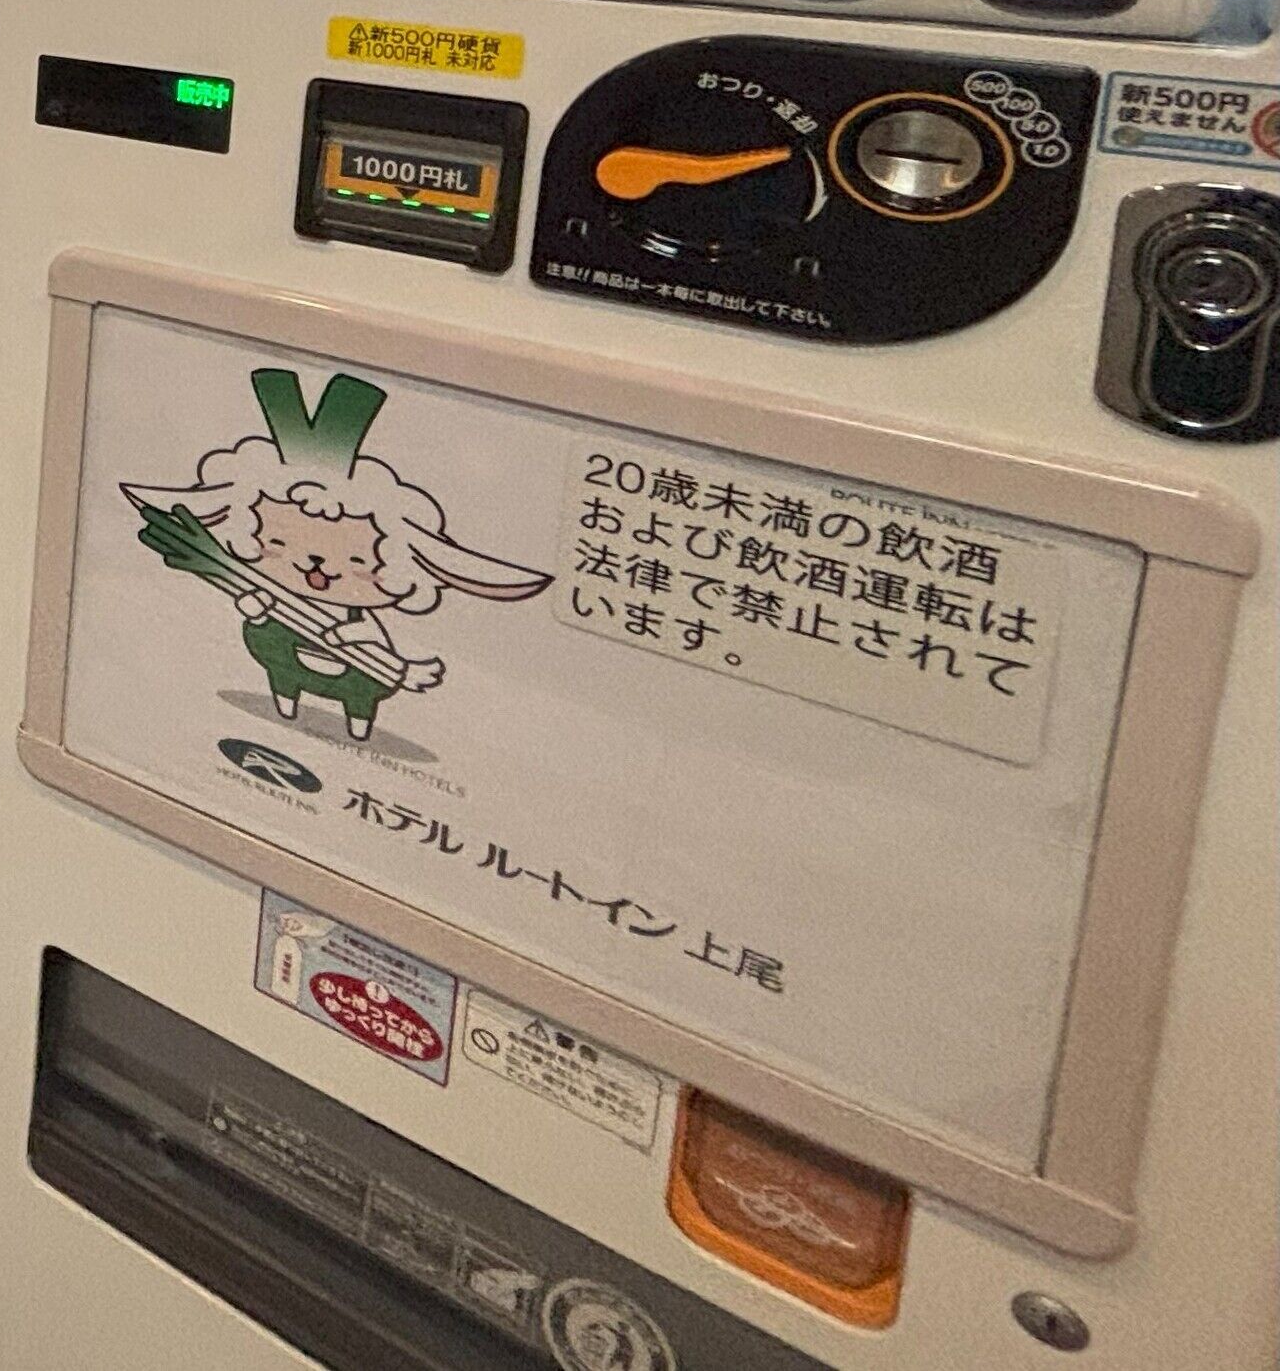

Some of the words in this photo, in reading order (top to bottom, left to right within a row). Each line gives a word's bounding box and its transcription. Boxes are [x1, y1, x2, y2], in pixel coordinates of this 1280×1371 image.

[348, 42, 436, 67] 新1000円札
[446, 53, 496, 72] 未対応
[370, 24, 501, 56] 新500円硬貨
[176, 79, 230, 108] 販売中
[1120, 82, 1250, 113] 新500円
[352, 154, 469, 191] 1000円札
[583, 453, 1003, 585] 20歳未満の飲酒
[580, 498, 1037, 646] および飲酒運転は
[571, 585, 744, 668] います。
[573, 538, 1032, 698] 法律で禁止されて
[343, 787, 465, 855] ホテル
[478, 842, 678, 937] ルートイン
[684, 930, 785, 993] 上尾
